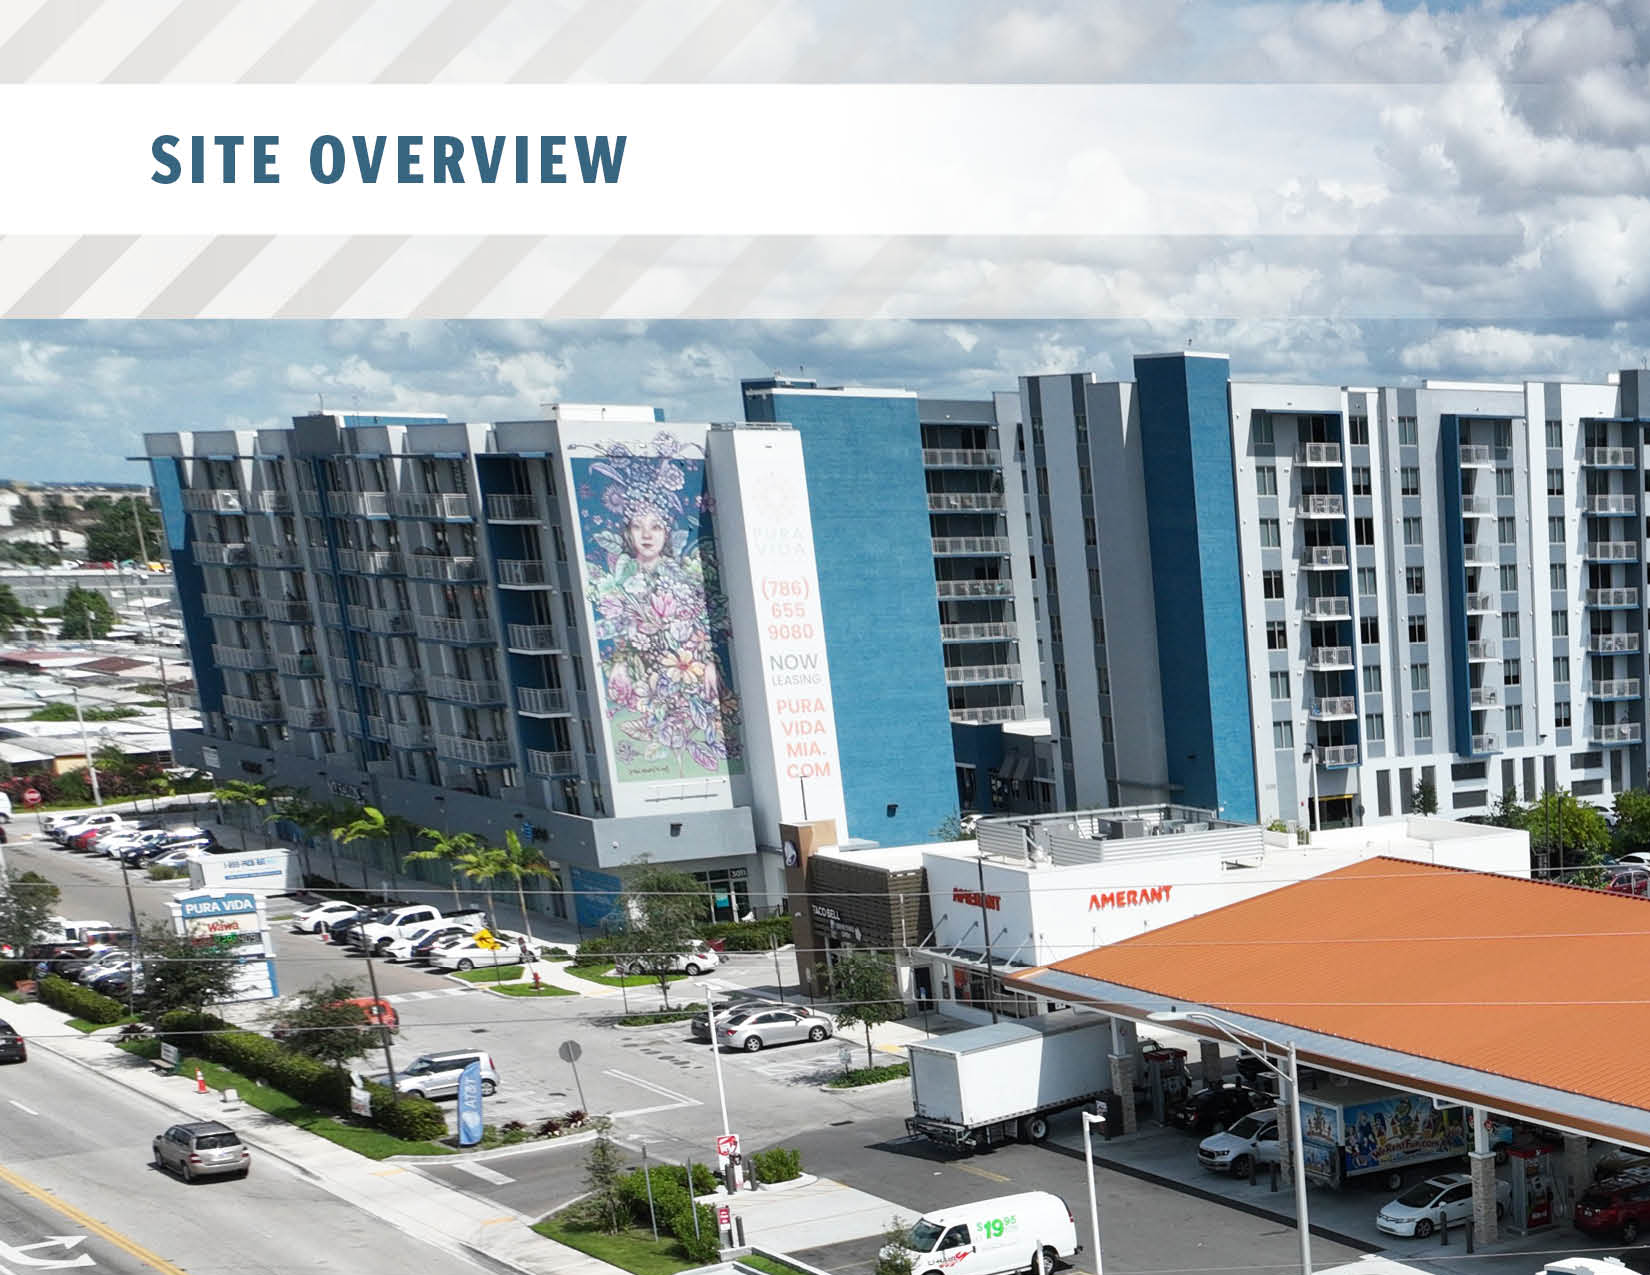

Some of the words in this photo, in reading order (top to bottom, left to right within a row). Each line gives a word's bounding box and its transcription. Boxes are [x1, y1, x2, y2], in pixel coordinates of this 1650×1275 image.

[762, 576, 809, 600] (786)
[771, 602, 806, 618] 655
[768, 623, 814, 640] 9080
[769, 654, 818, 671] NOW
[771, 673, 822, 687] LEASING
[776, 697, 825, 715] PURA
[780, 719, 827, 736] VIDA
[786, 741, 827, 758] MIA.
[786, 761, 831, 779] COM
[185, 902, 220, 914] PURA
[222, 899, 253, 911] VIDA
[1088, 885, 1172, 911] AMERANT
[207, 920, 239, 932] Wawa
